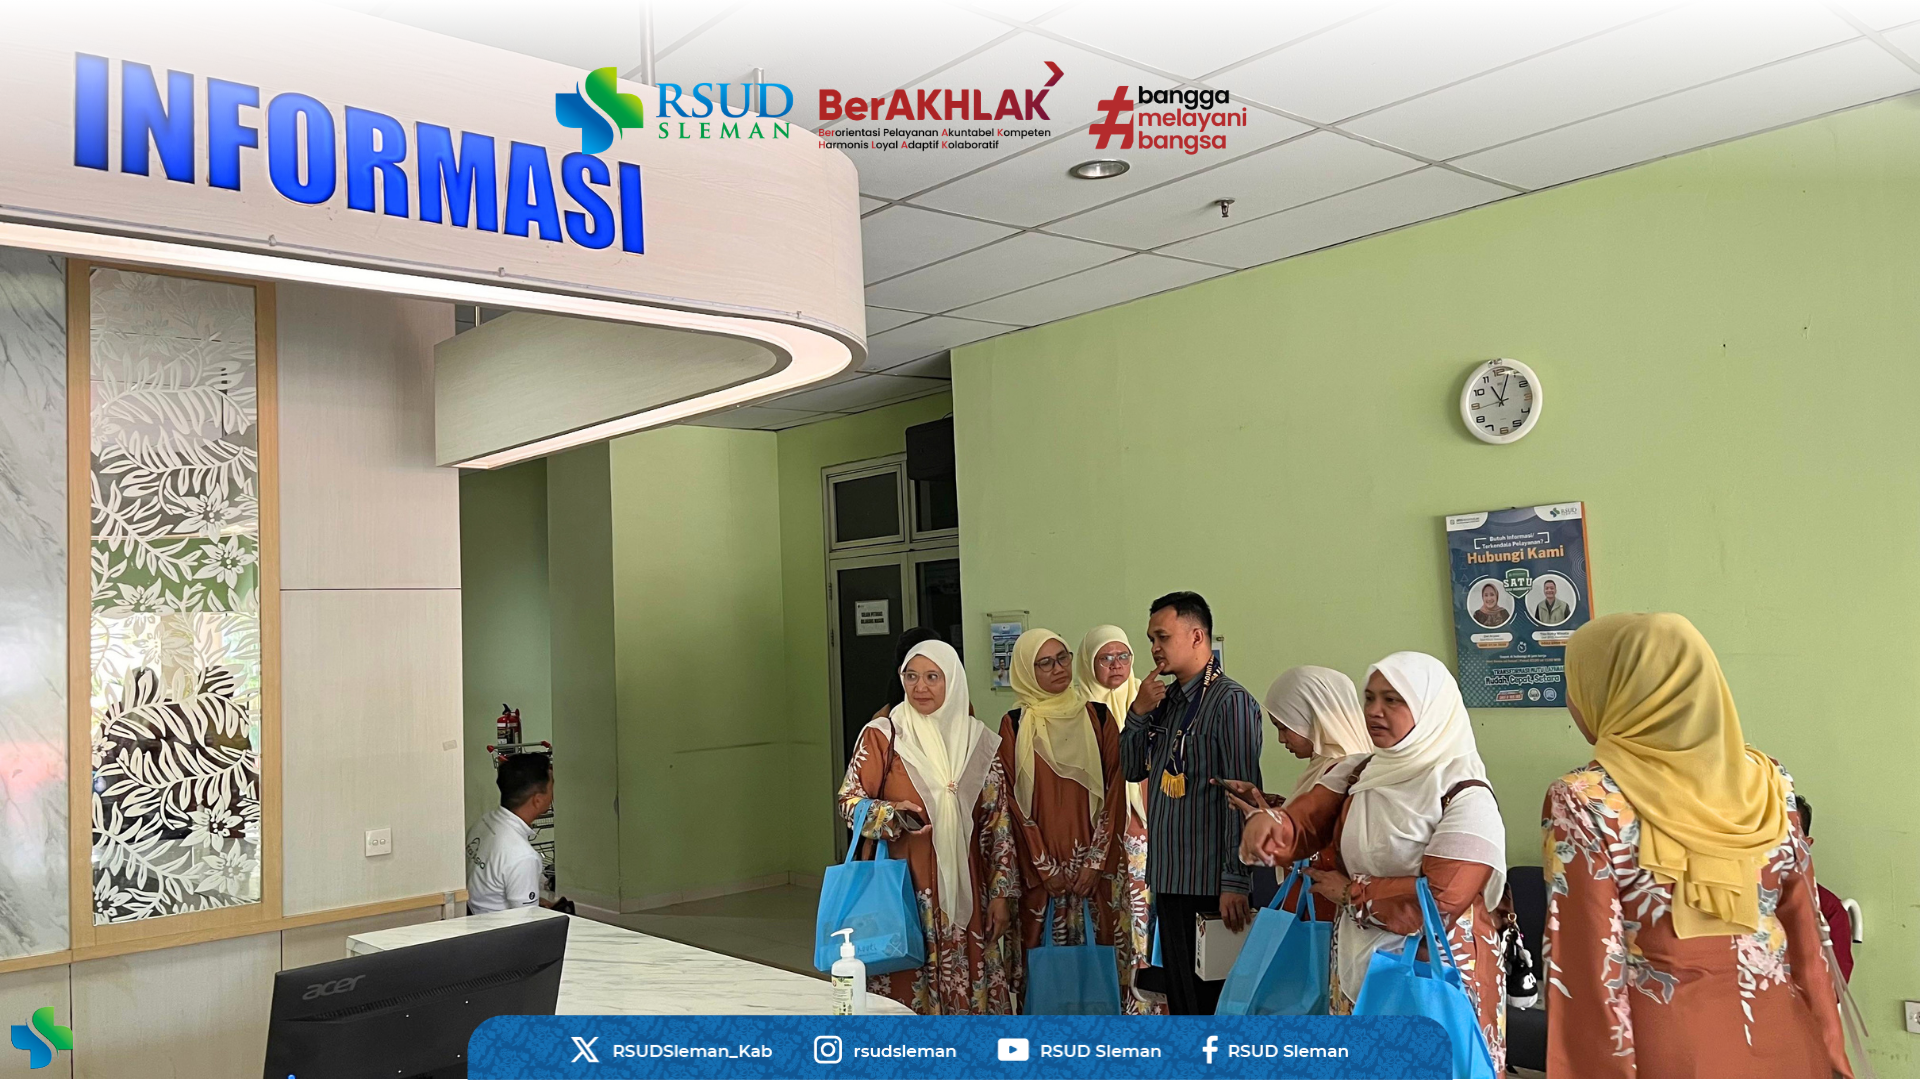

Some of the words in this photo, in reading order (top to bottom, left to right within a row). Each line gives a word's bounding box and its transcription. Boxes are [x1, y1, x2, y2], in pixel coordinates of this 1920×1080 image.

[73, 51, 646, 255] INFORMASI
[1482, 376, 1489, 384] 11
[1518, 380, 1528, 388] 2
[1473, 388, 1485, 396] 10
[1476, 415, 1485, 423] 8
[1482, 541, 1511, 549] Terkendala
[1512, 538, 1544, 547] Pelayanan?
[1467, 548, 1525, 564] Hubungi
[1527, 545, 1564, 560] Kami
[1503, 577, 1533, 588] SATU
[1485, 676, 1509, 685] Mudah,
[1509, 674, 1534, 686] Cepat,
[1534, 674, 1561, 684] Setara
[302, 974, 366, 1000] acer
